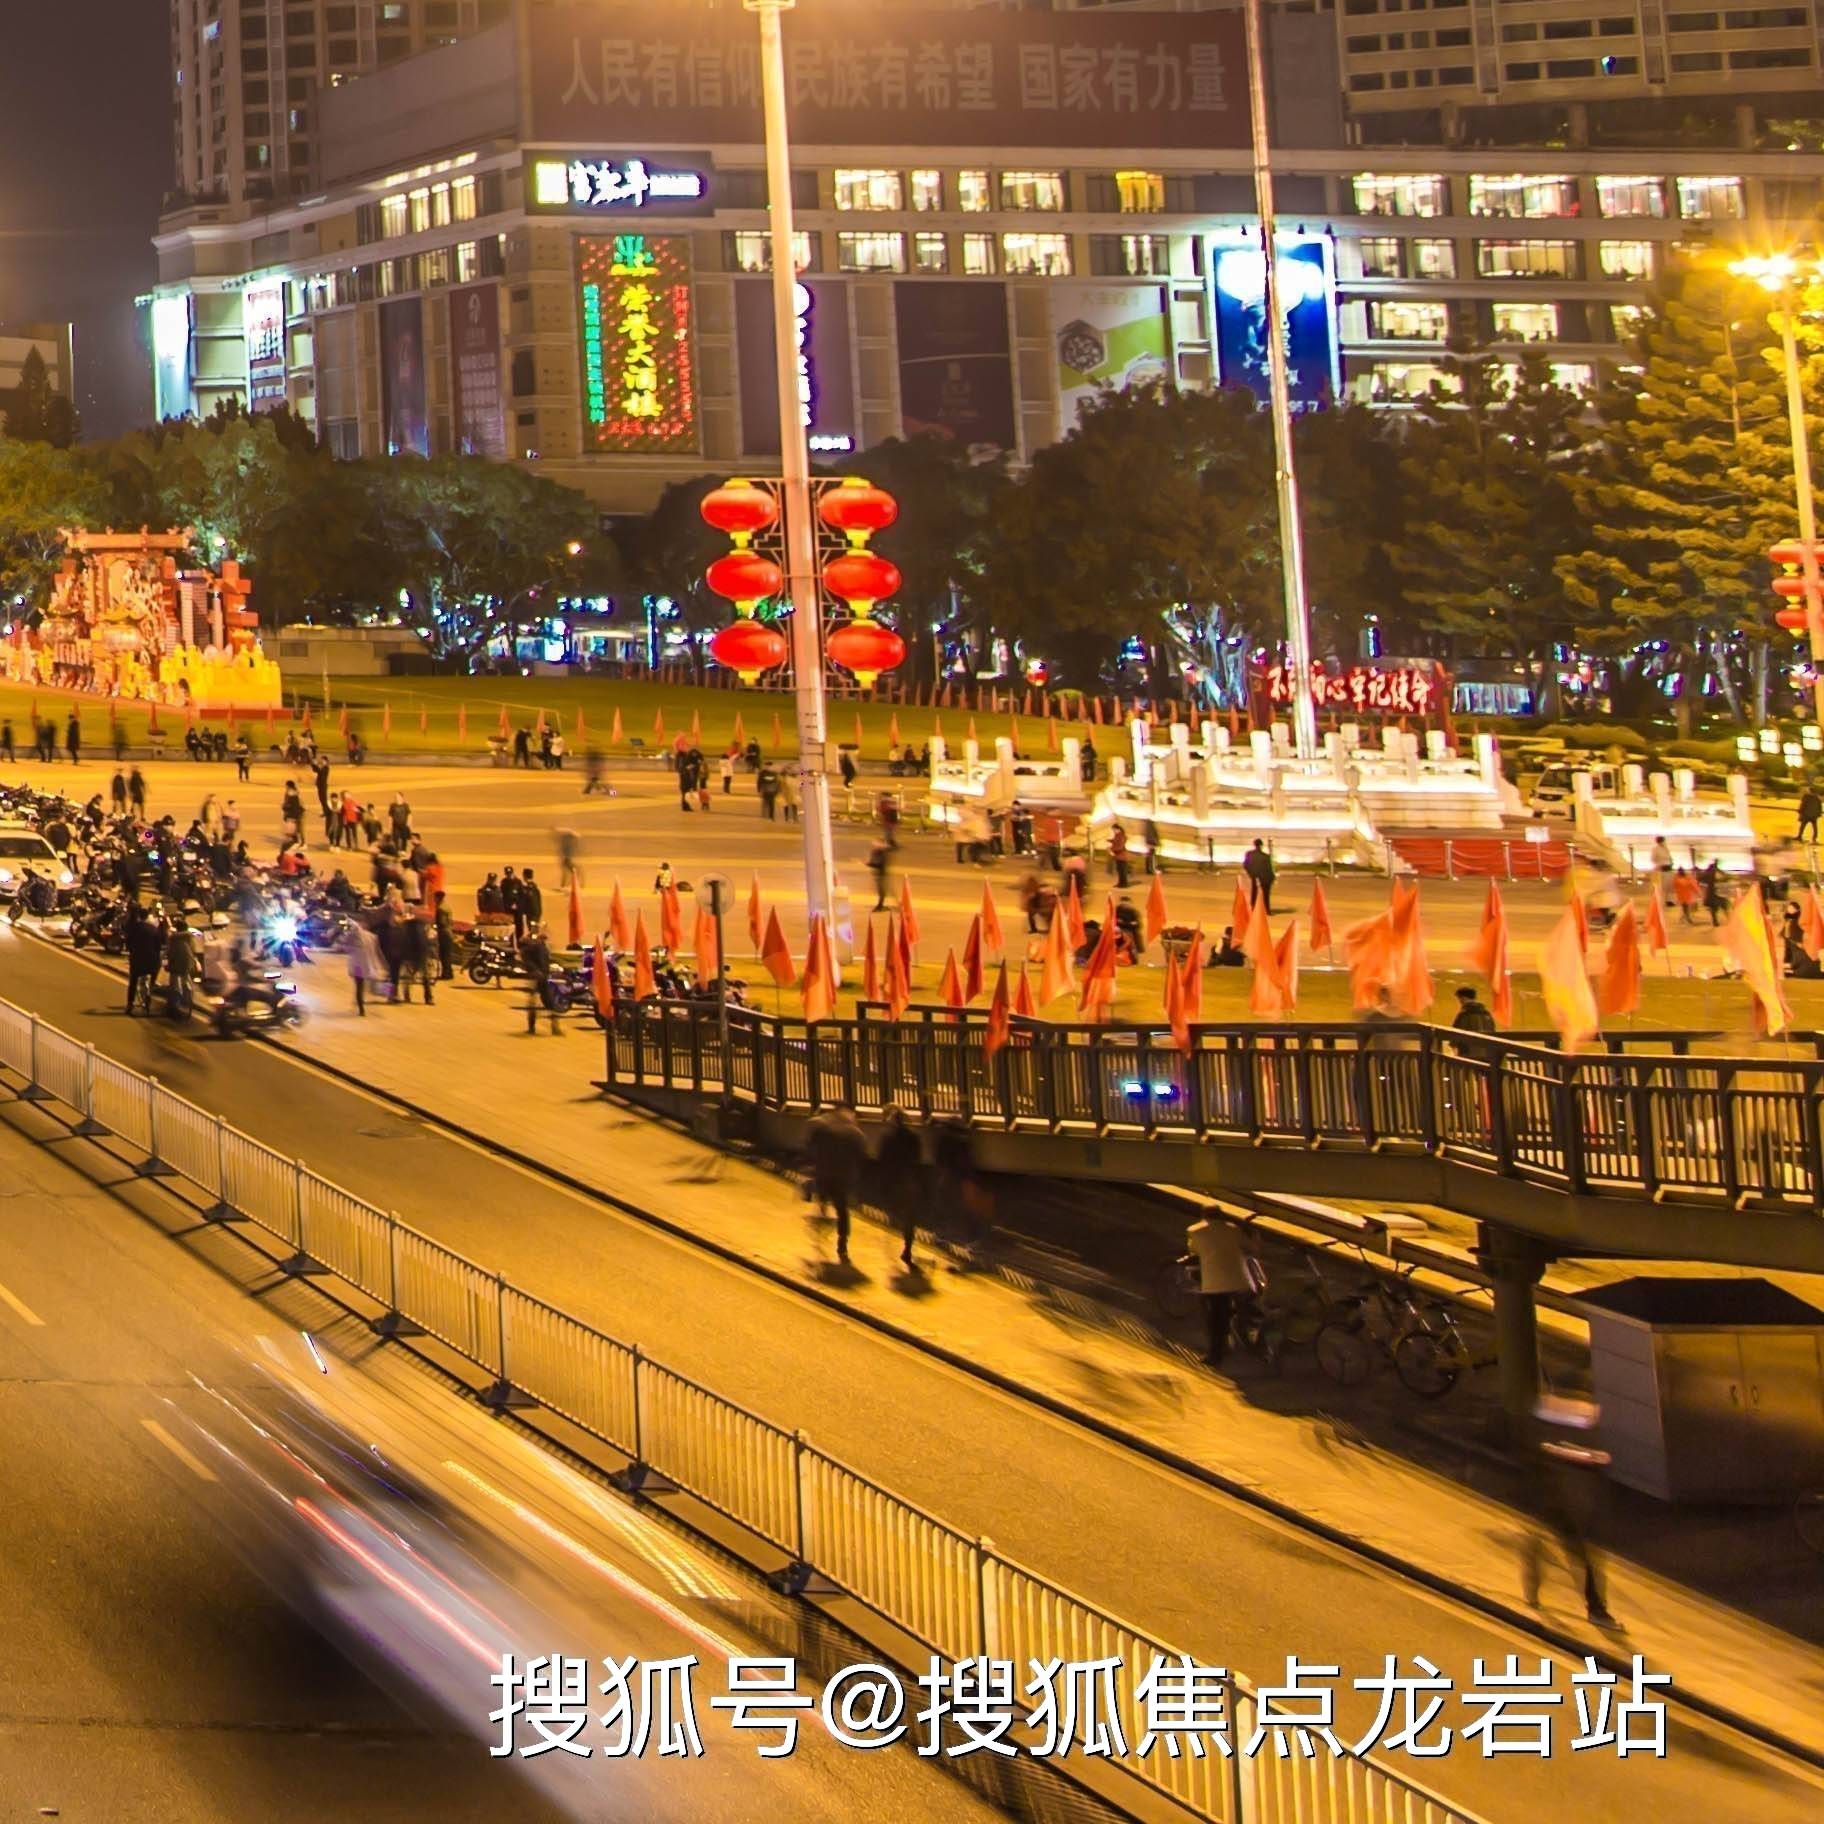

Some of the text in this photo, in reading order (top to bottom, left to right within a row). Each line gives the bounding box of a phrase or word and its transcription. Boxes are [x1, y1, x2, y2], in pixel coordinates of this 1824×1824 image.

[1018, 40, 1229, 113] 国家有力量
